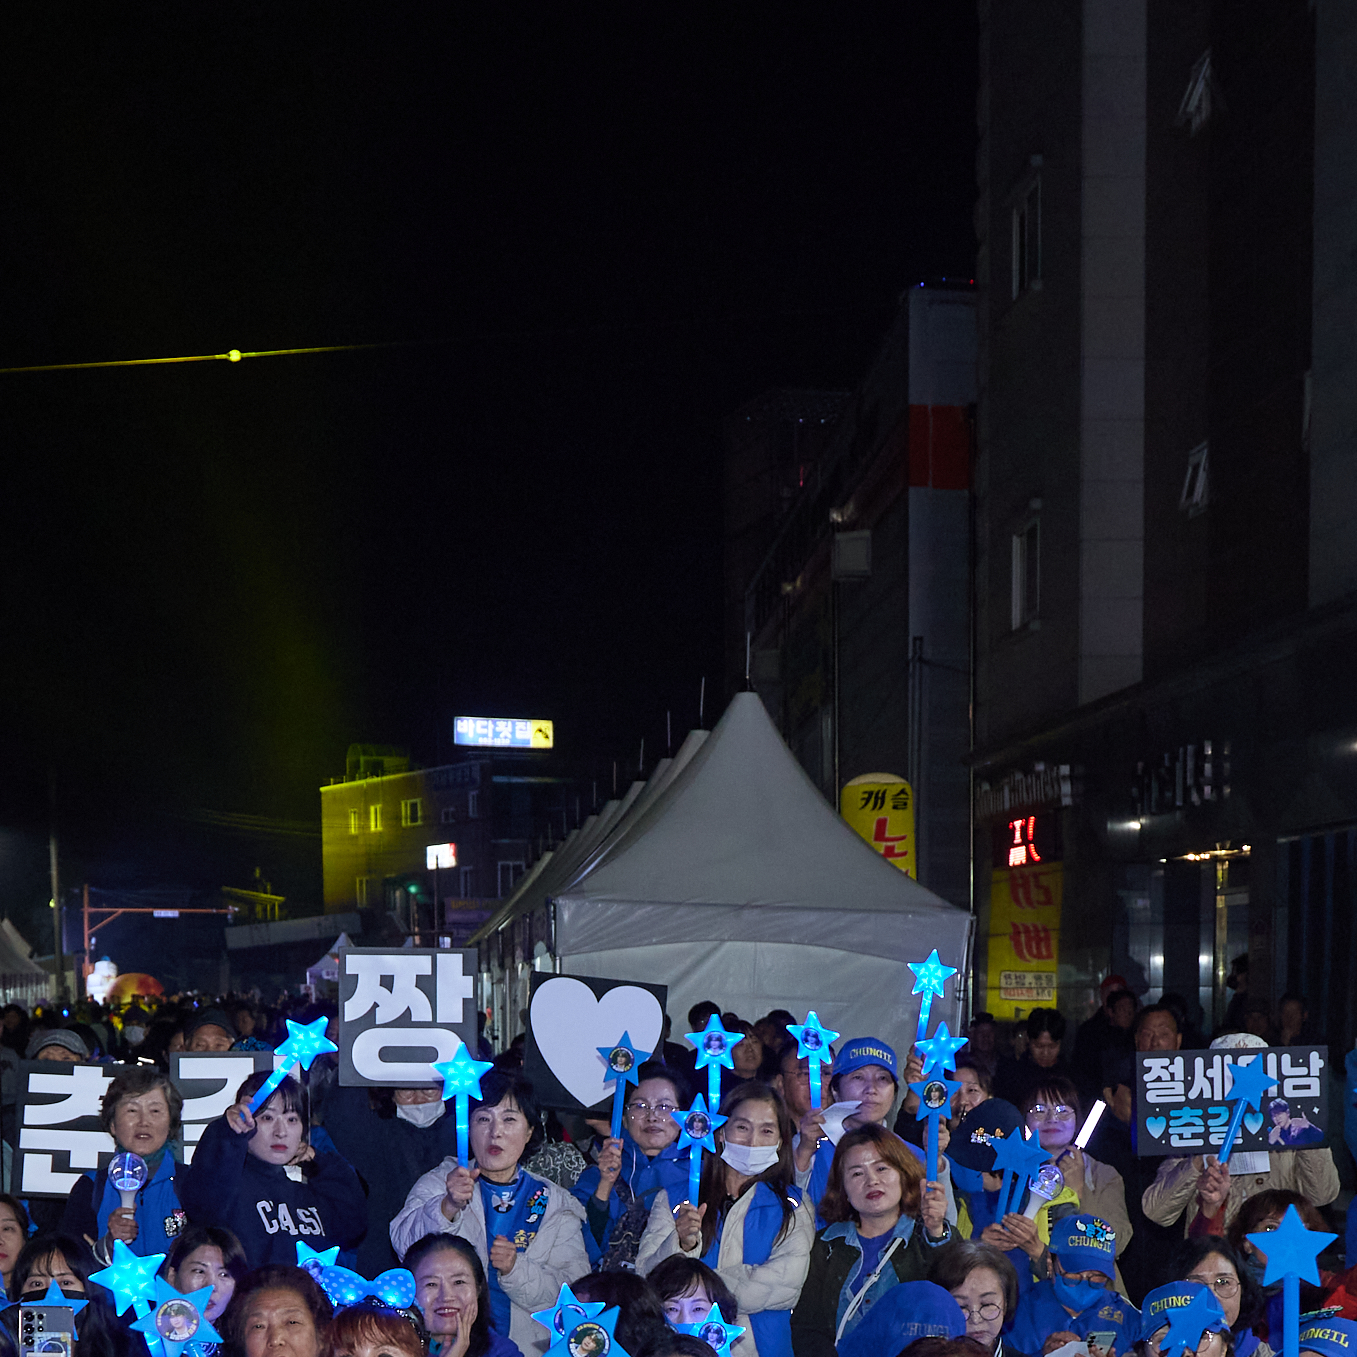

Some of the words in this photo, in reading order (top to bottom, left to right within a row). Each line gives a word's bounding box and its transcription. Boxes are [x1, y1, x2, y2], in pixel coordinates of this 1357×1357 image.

[457, 718, 531, 740] 바다횟집
[859, 788, 910, 812] 캐슬
[343, 952, 475, 1082] 짱
[1142, 1049, 1325, 1105] 절세남
[1168, 1106, 1244, 1148] 춘길
